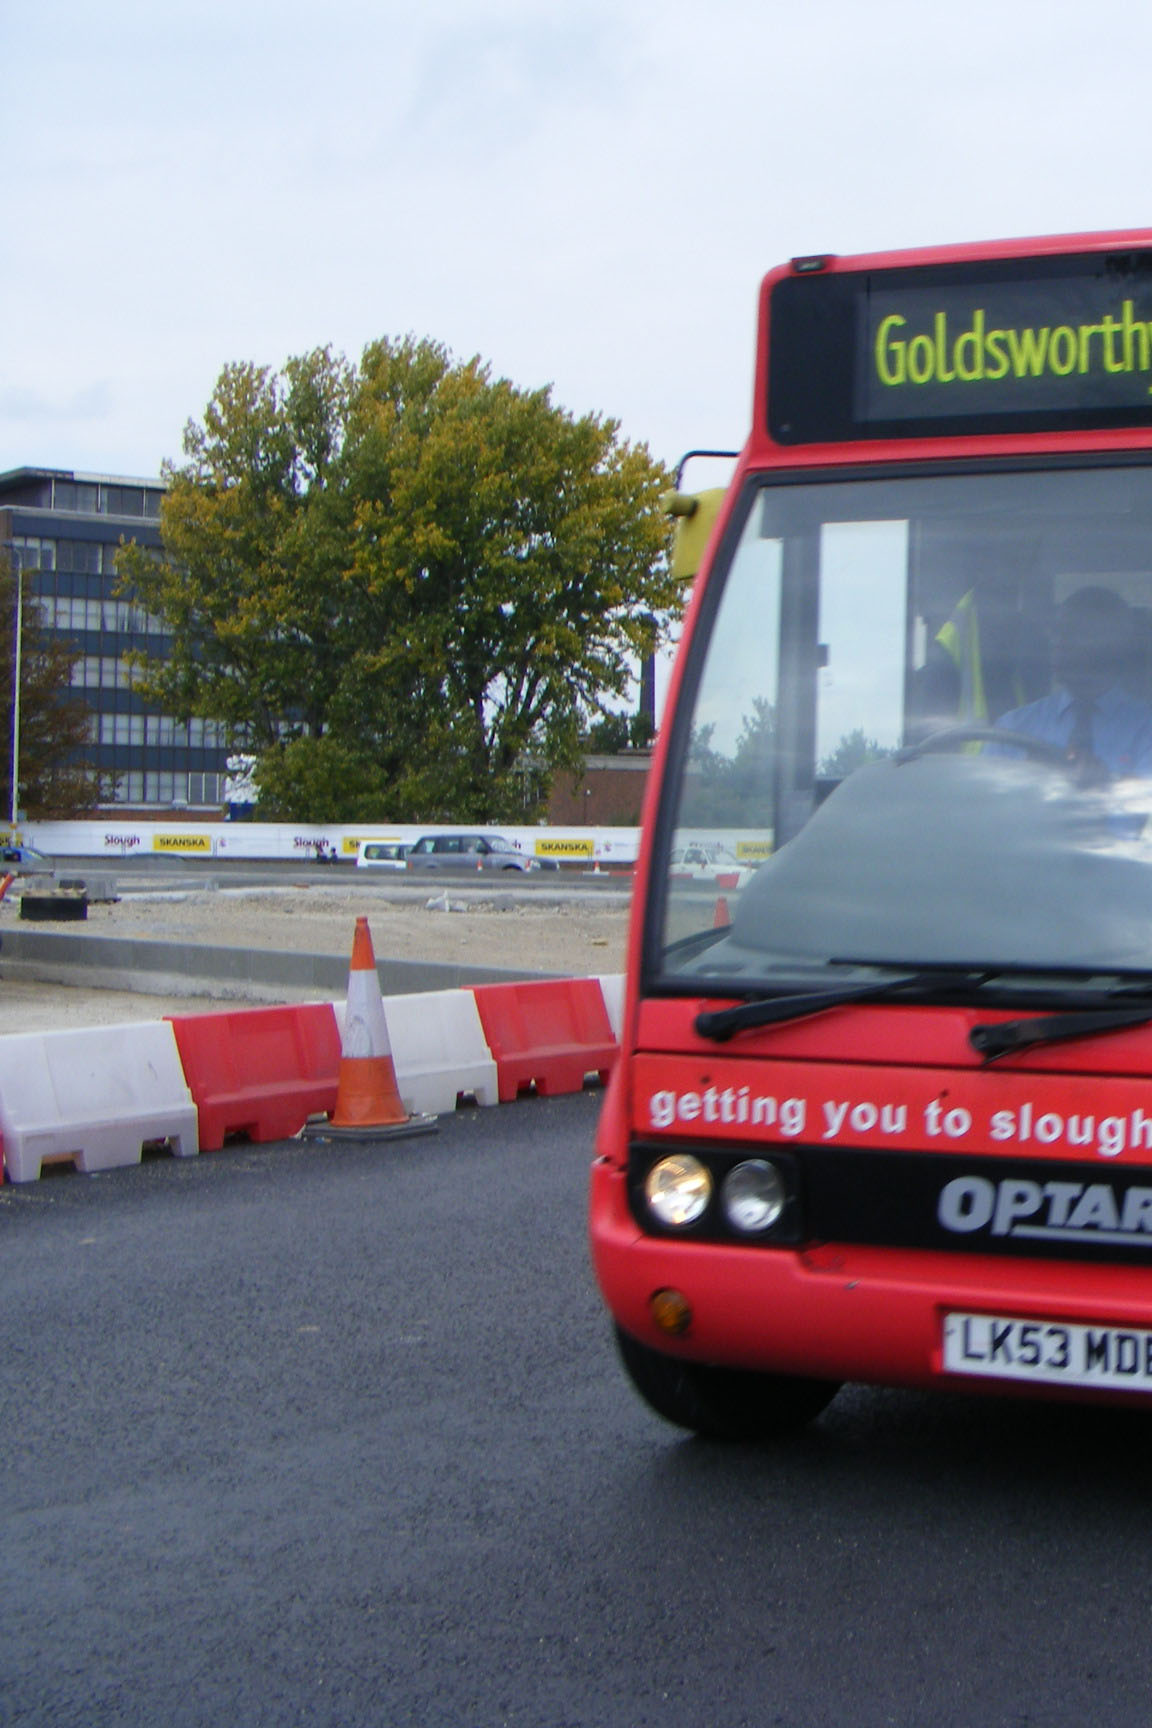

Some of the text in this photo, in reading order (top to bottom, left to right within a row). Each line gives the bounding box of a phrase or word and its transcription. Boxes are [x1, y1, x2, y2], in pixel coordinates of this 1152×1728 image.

[104, 834, 140, 847] Slough
[159, 838, 205, 847] SKANSKA
[541, 842, 589, 852] SKANSKA
[649, 1086, 807, 1137] getting
[822, 1100, 907, 1139] you
[924, 1100, 972, 1138] to
[961, 1317, 1072, 1369] LK53
